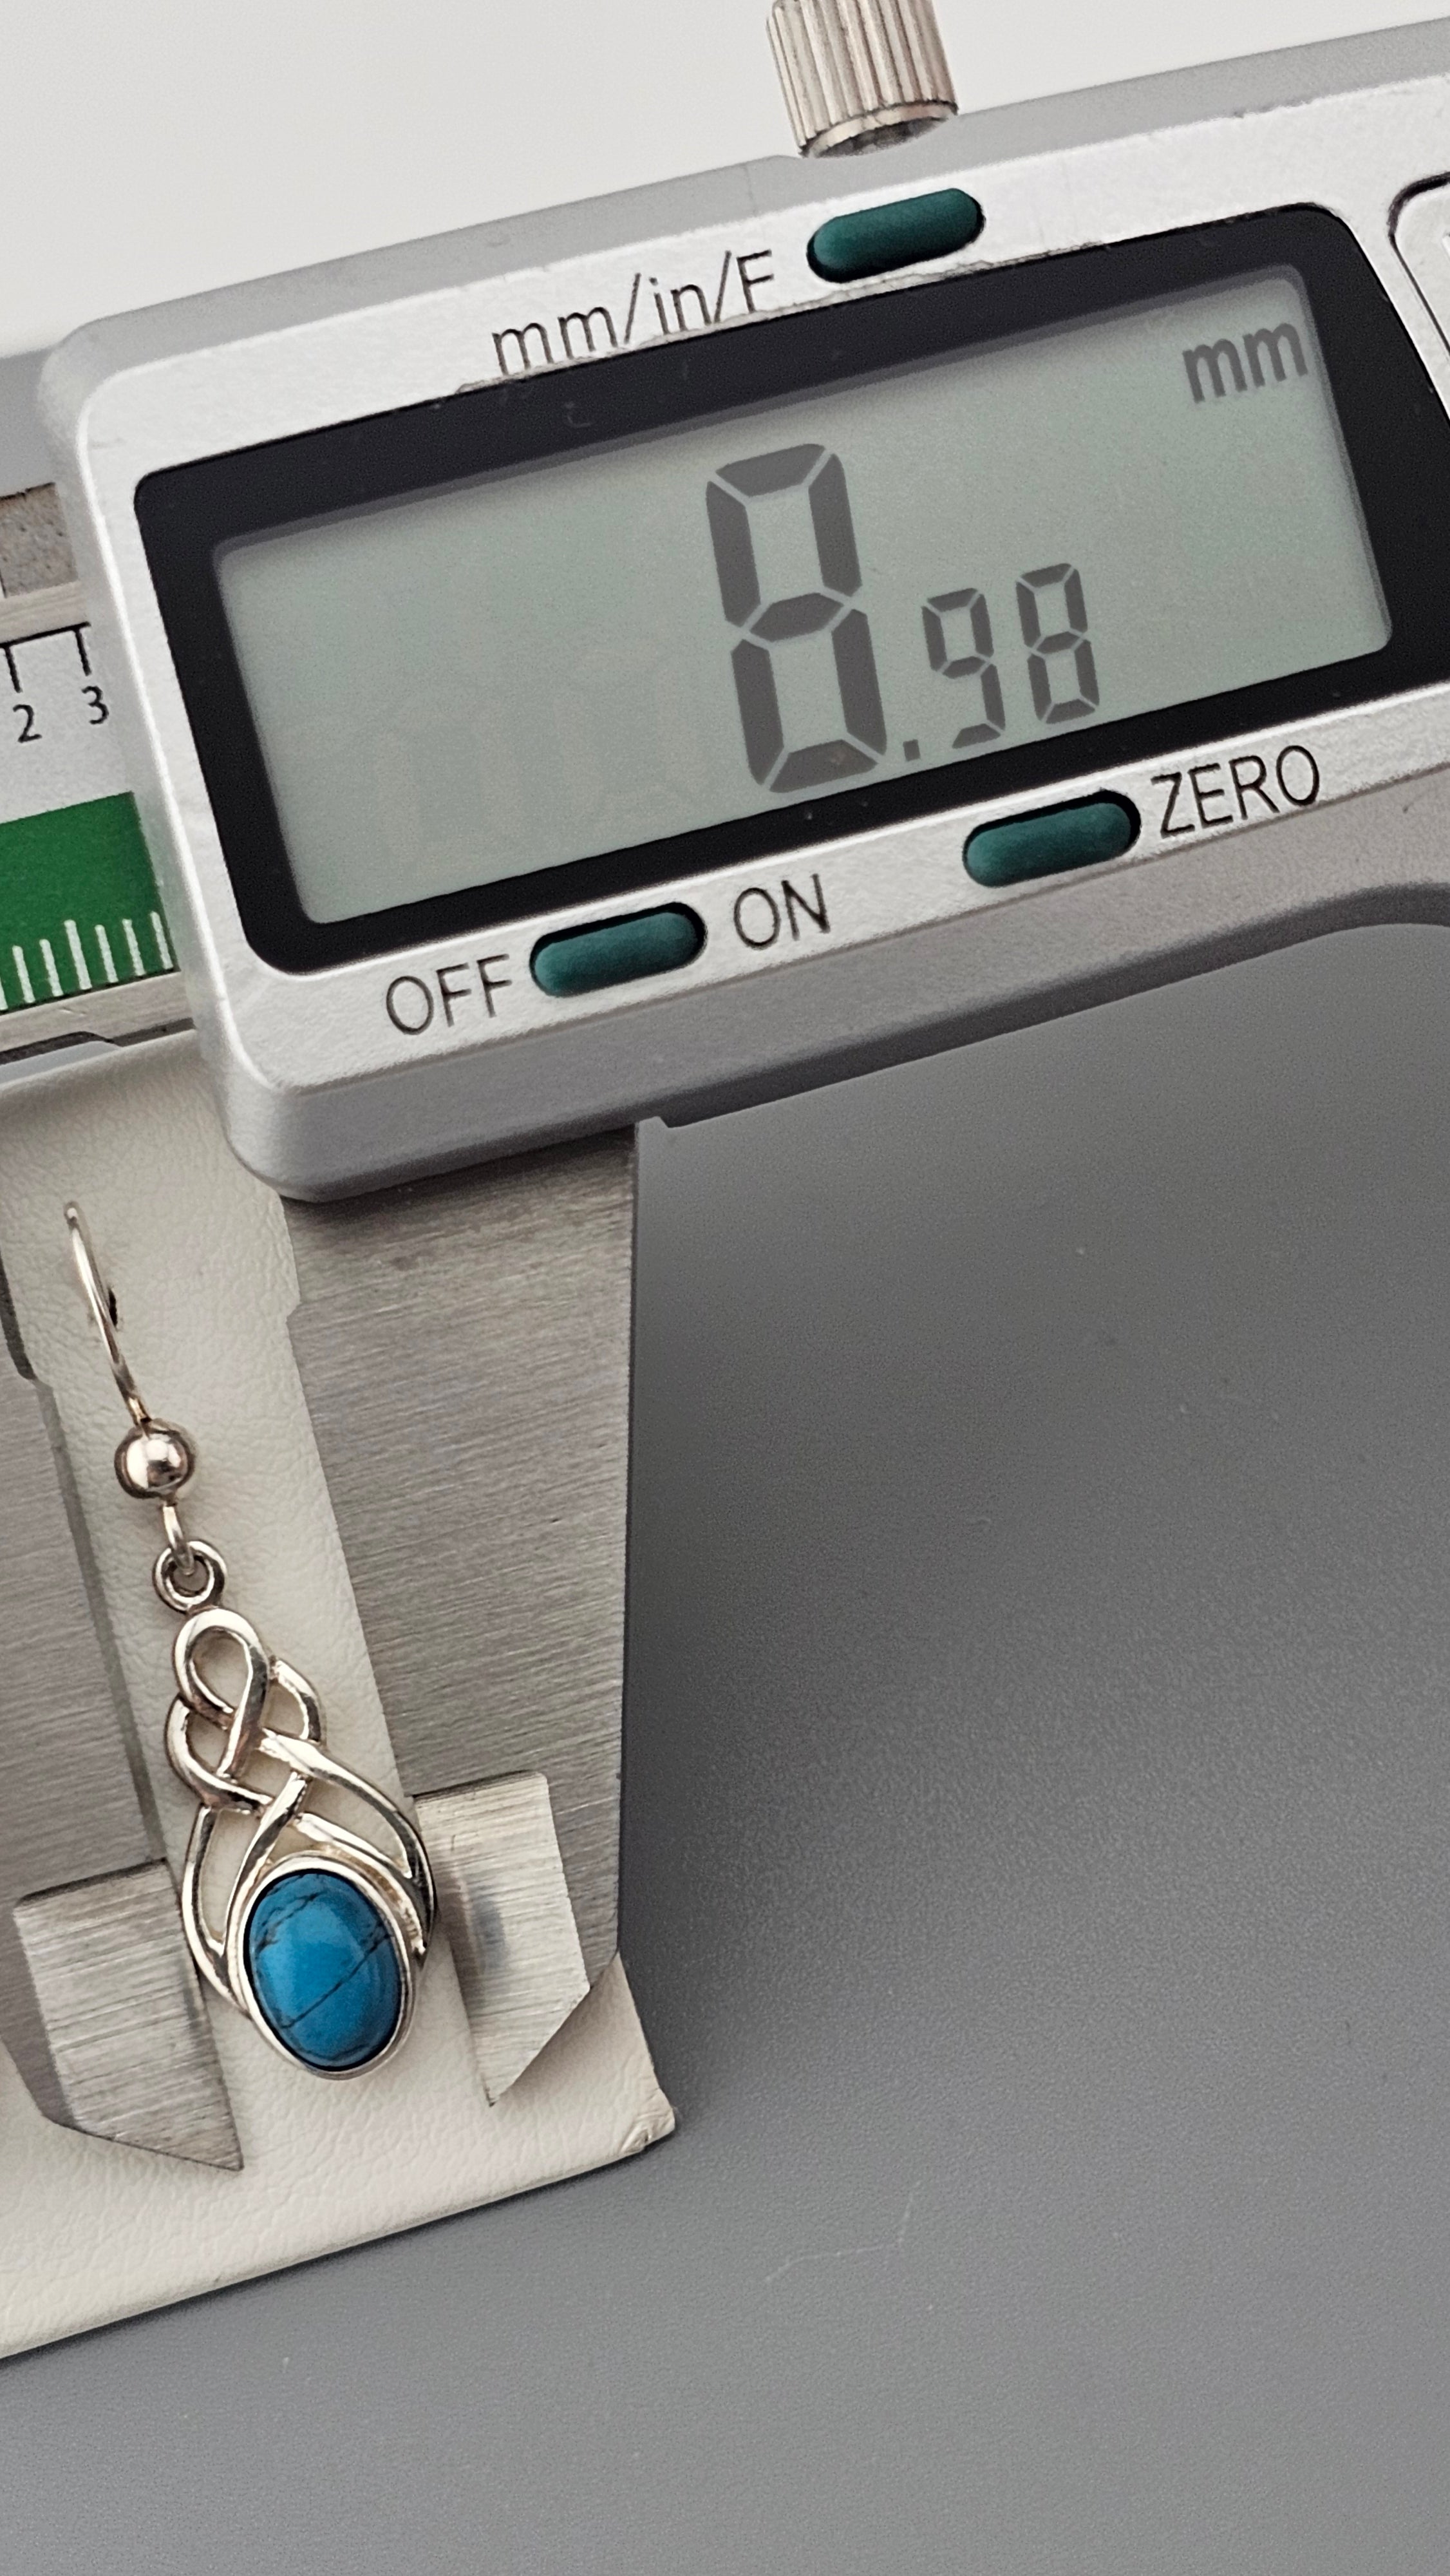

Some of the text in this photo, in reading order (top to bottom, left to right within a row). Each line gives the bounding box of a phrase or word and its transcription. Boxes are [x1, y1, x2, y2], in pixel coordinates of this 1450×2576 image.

[492, 249, 775, 375] mm/in/F
[1182, 323, 1308, 404] mm
[706, 443, 1100, 793] 8.98
[13, 685, 109, 743] 2 3
[1151, 744, 1320, 838] ZERO
[733, 873, 831, 950] ON
[386, 953, 512, 1035] OFF
